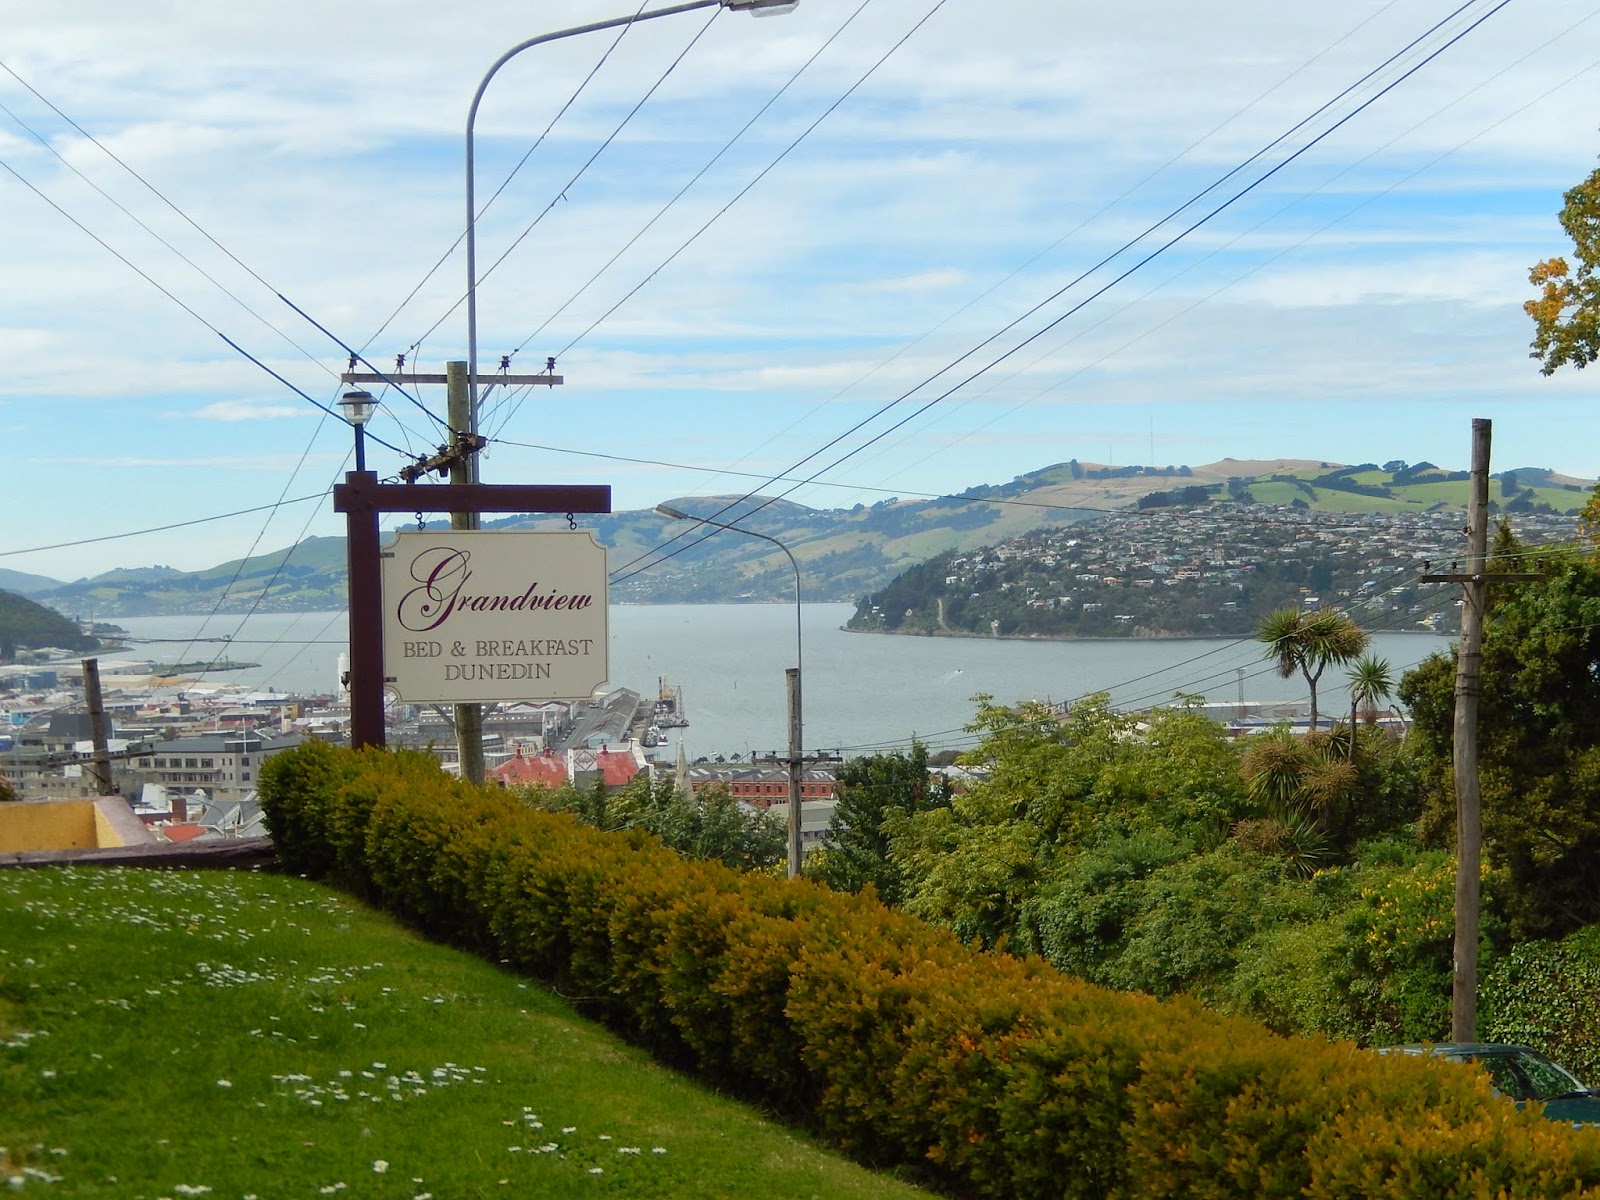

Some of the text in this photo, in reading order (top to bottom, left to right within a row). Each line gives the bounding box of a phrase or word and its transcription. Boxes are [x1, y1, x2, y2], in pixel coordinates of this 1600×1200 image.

[398, 547, 592, 632] Grandview
[403, 639, 594, 658] BED & BREAKFAST
[445, 663, 552, 681] DUNEDIN
